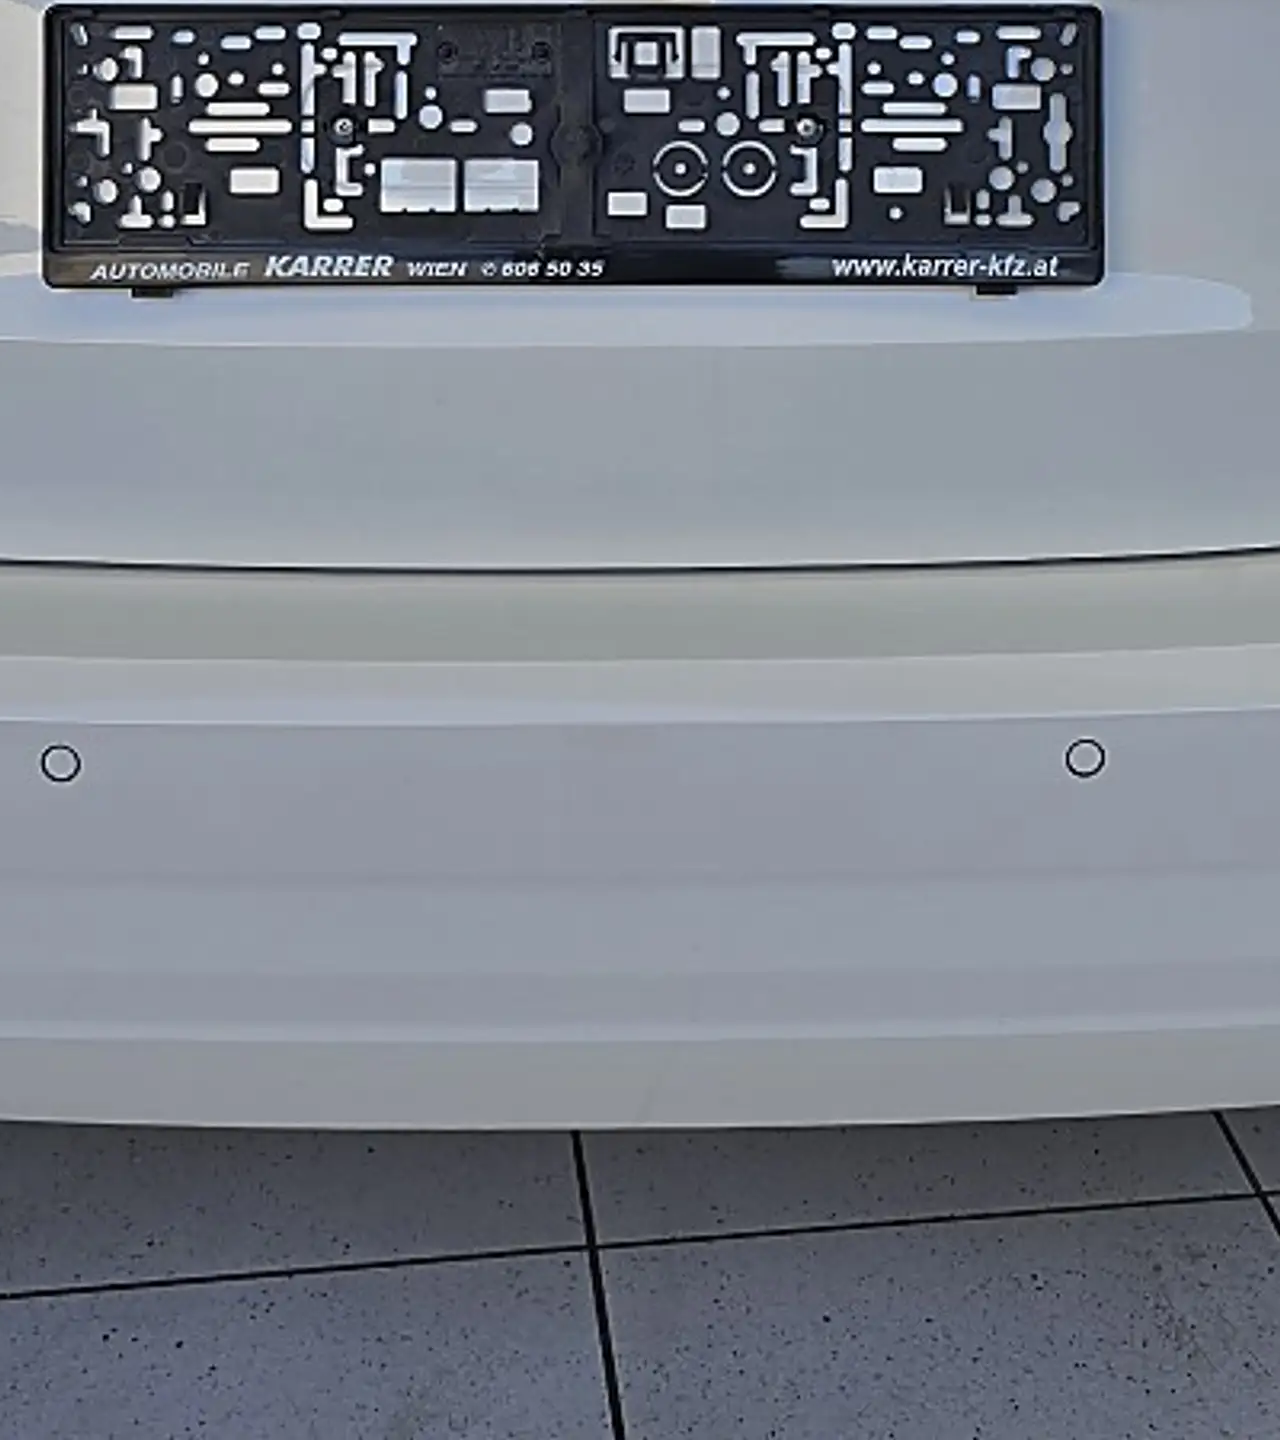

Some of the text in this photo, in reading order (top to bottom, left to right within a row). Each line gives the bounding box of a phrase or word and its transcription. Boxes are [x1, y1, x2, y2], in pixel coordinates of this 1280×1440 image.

[90, 262, 250, 280] AUTOMOBILE
[265, 255, 394, 277] KARRER
[407, 262, 468, 277] WIEN
[545, 261, 571, 277] 50
[575, 261, 605, 277] 35
[832, 253, 1059, 278] www.karrer-kfz.at
